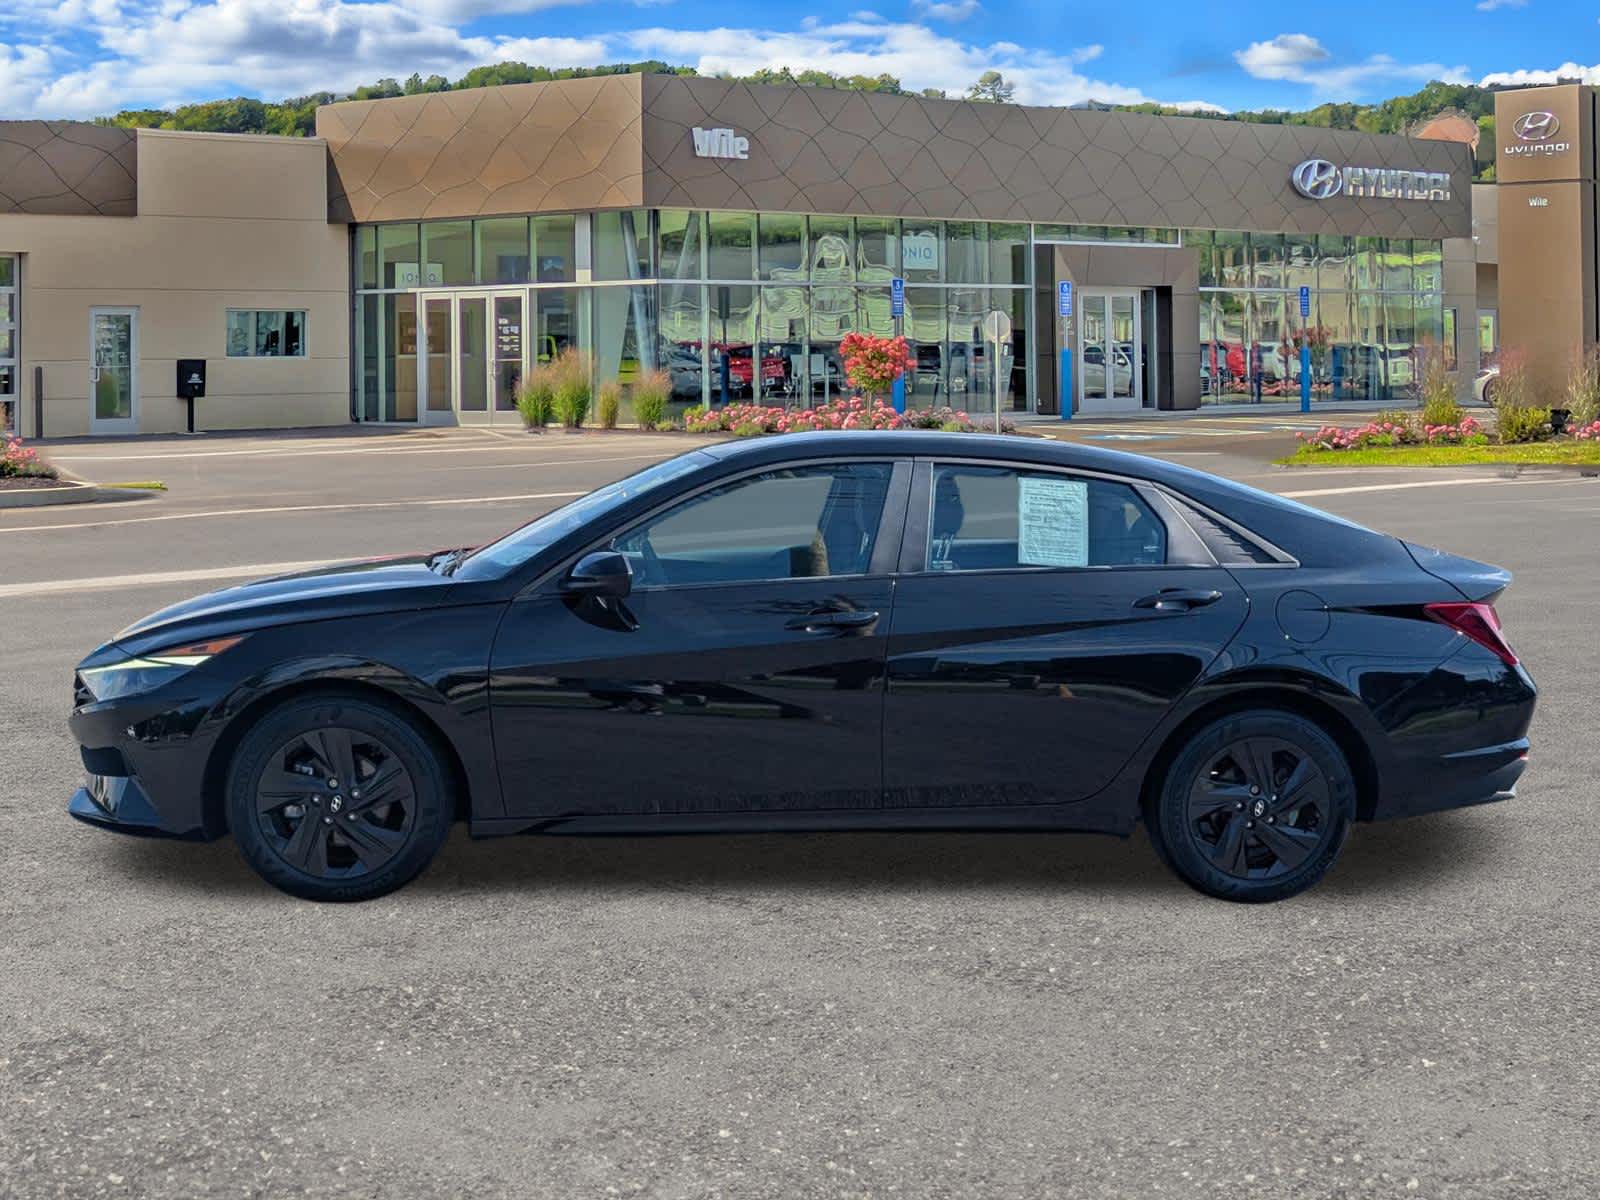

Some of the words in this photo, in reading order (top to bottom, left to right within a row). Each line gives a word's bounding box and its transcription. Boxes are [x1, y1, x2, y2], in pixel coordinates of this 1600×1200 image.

[692, 127, 749, 160] Wile
[1343, 166, 1450, 201] HYUNDAI
[1528, 196, 1549, 208] Wile
